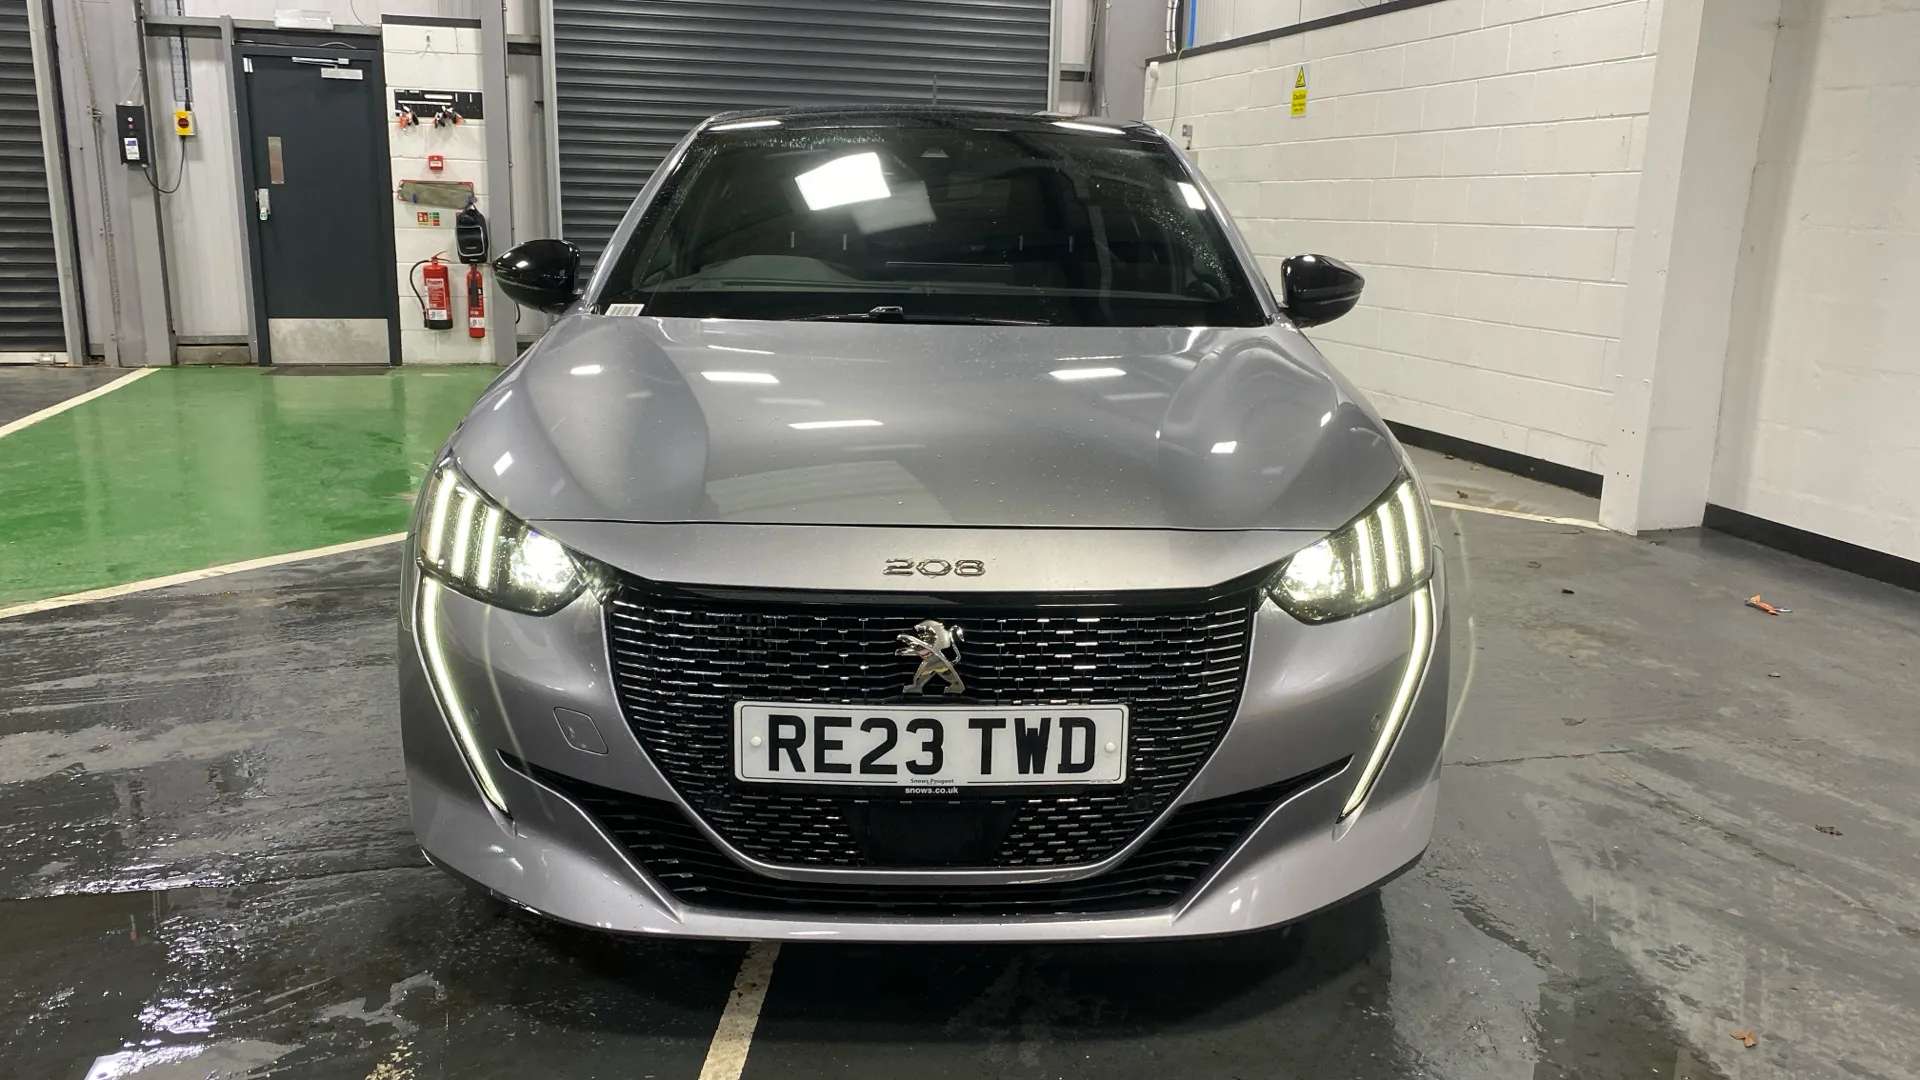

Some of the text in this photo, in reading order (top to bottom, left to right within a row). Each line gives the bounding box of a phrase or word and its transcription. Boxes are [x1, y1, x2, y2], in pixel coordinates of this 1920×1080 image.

[883, 559, 986, 577] 208
[768, 714, 1096, 775] RE23 TWD
[905, 786, 959, 794] snows.co.uk
